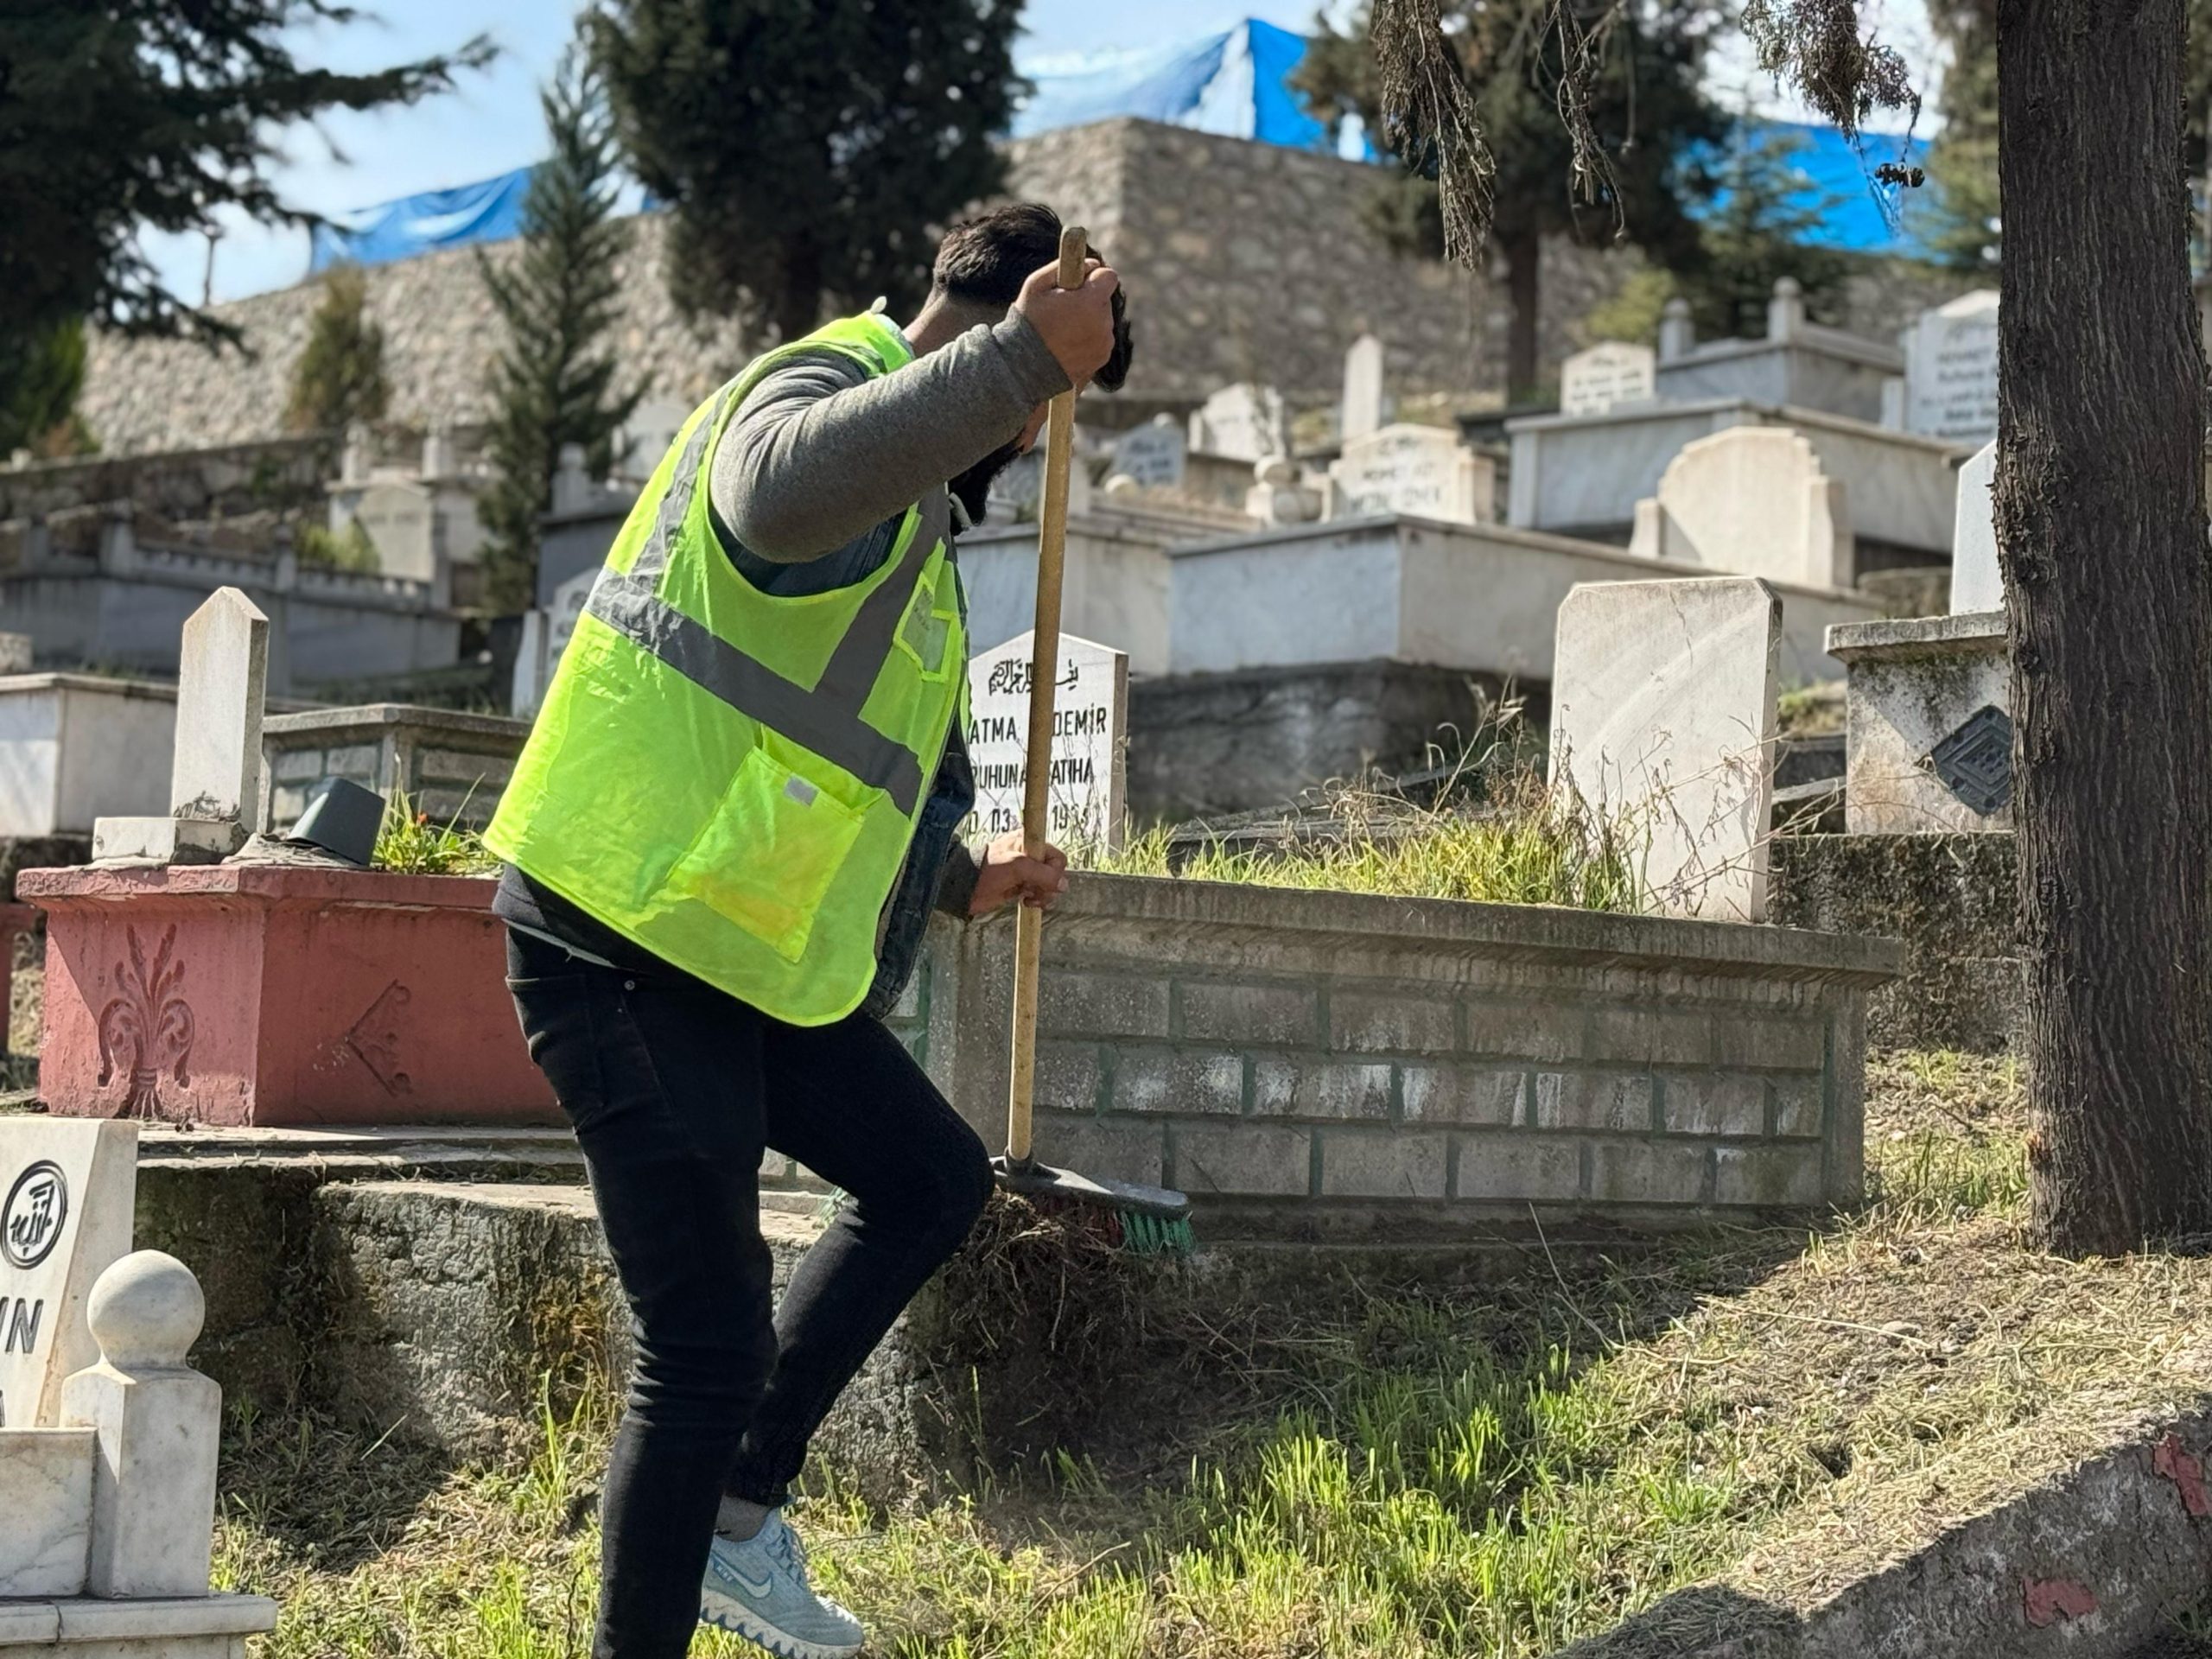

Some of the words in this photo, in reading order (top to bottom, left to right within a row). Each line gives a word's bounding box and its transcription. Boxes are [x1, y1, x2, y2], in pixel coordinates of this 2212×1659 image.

[969, 716, 1017, 745] ATMA
[1052, 702, 1107, 737] DEMİR
[1050, 757, 1095, 785] ATIHA
